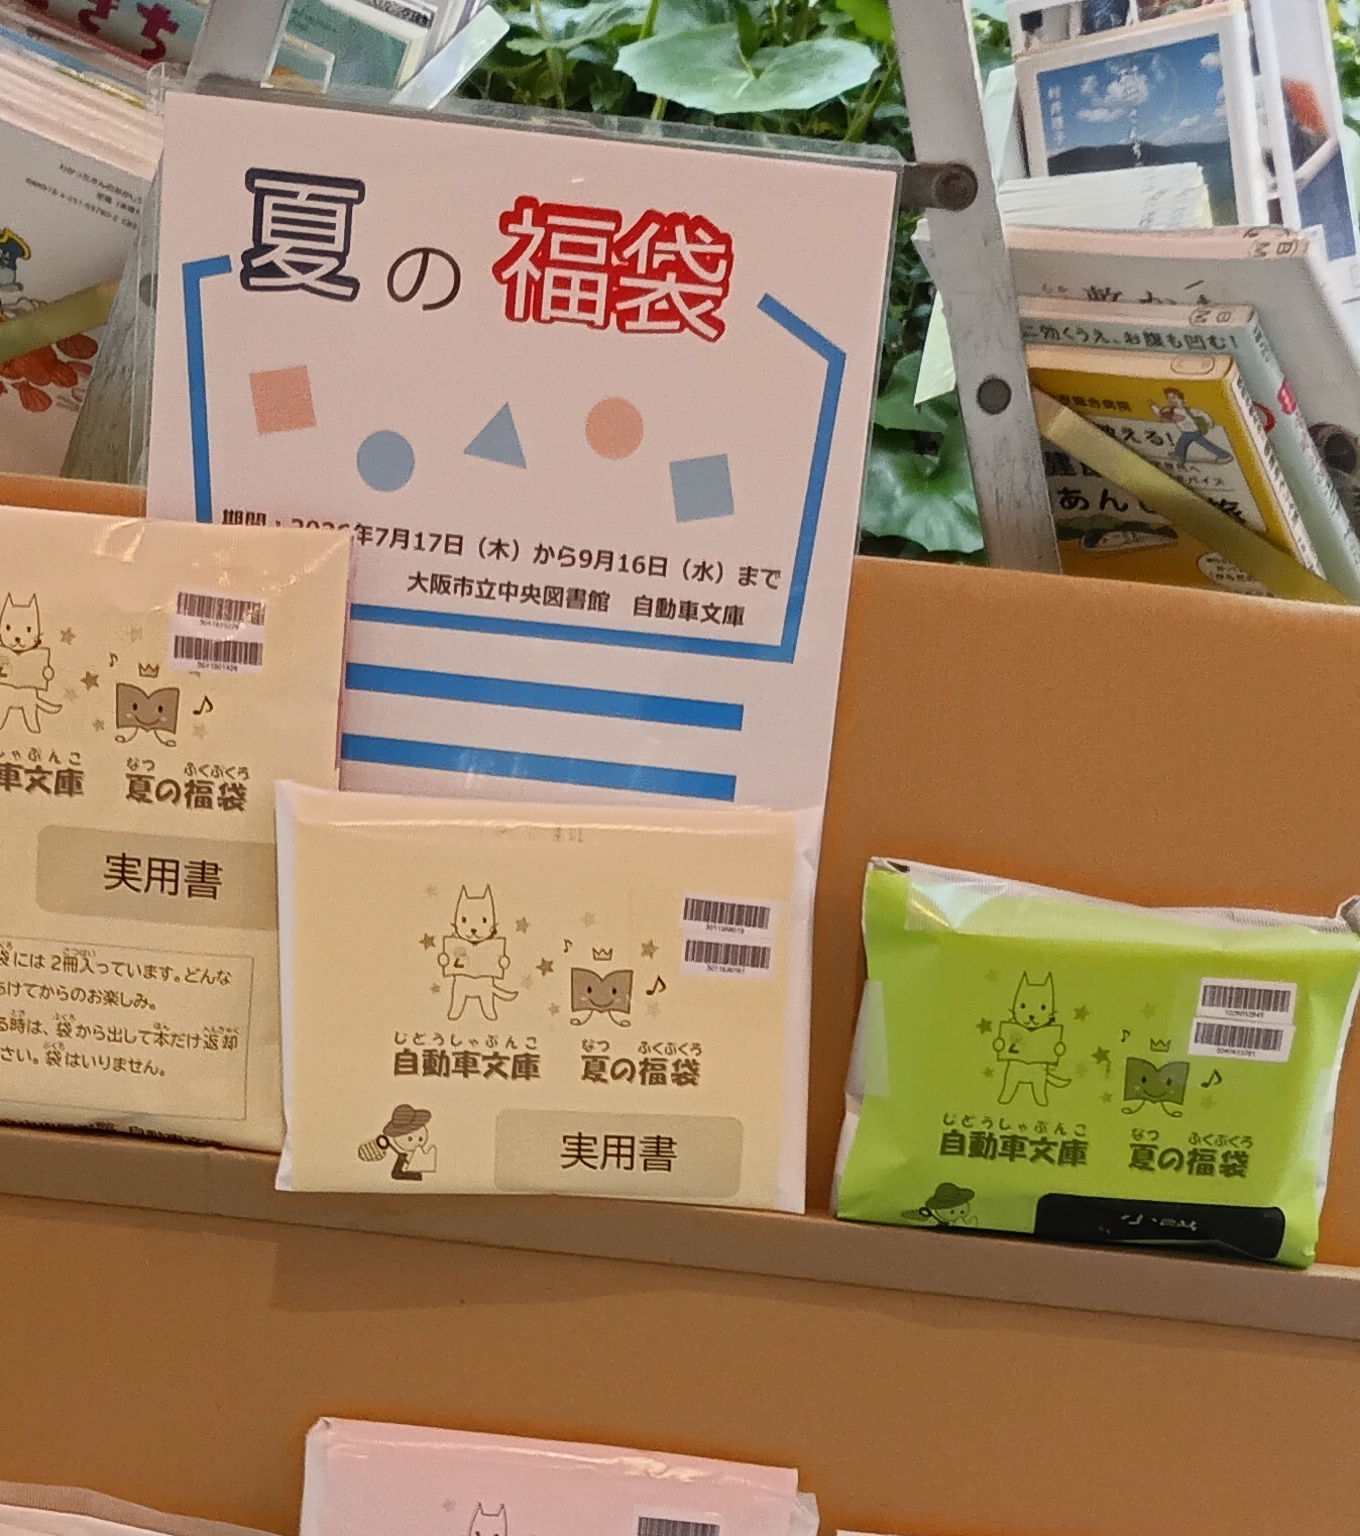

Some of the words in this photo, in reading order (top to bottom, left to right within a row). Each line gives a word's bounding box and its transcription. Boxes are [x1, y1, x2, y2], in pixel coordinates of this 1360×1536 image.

[240, 167, 734, 341] 夏の福袋
[407, 571, 610, 614] 大阪市立中央図書館
[632, 595, 746, 628] 自動車文庫
[125, 771, 248, 812] 夏の福袋
[103, 852, 224, 900] 実用書
[393, 1048, 540, 1080] 自動車文庫
[581, 1055, 701, 1086] 夏の福袋
[560, 1132, 678, 1173] 実用書
[940, 1130, 1088, 1167] 自動車文庫
[1129, 1143, 1250, 1178] 夏の福袋
